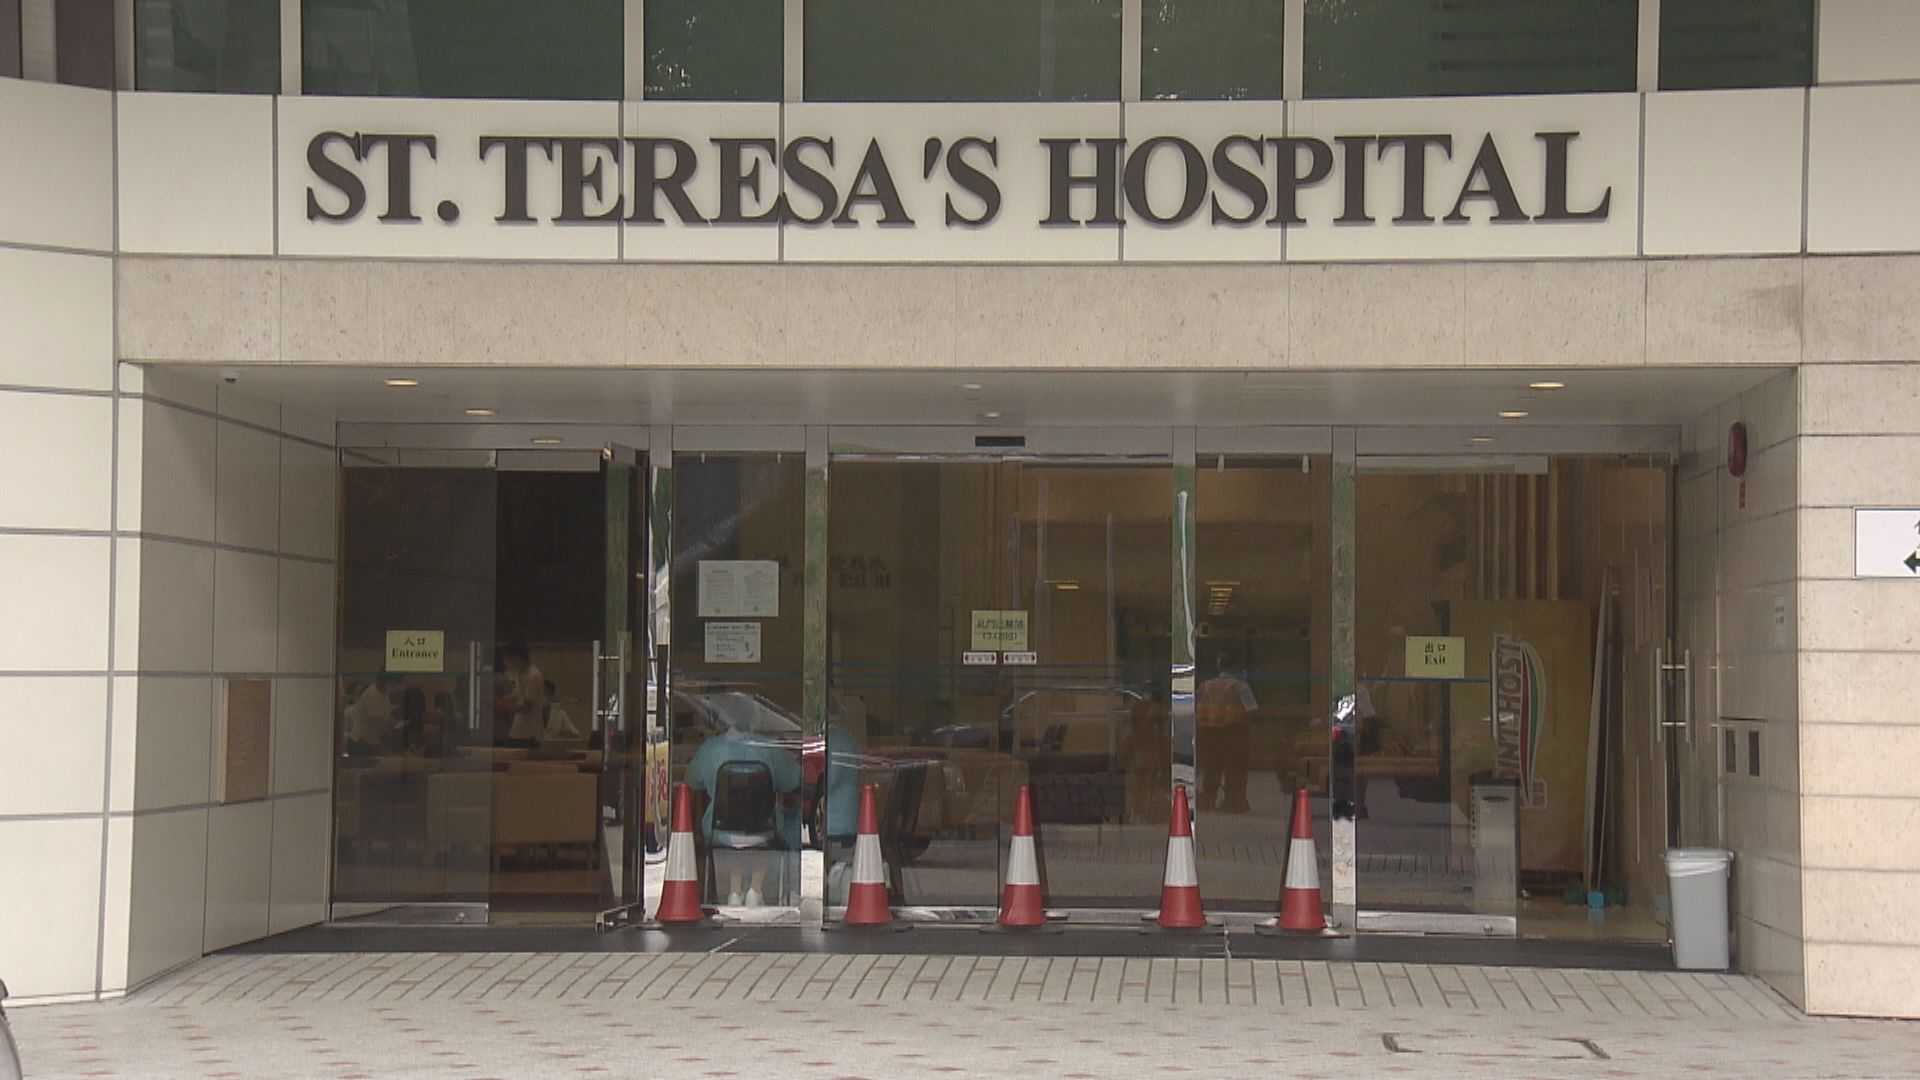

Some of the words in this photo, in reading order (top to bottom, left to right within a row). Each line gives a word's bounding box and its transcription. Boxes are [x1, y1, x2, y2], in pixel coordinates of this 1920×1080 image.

[306, 131, 461, 222] ST.
[478, 134, 1002, 227] TERESA'S
[1038, 131, 1612, 227] HOSPITAL
[404, 637, 426, 647] 入口
[1424, 641, 1446, 653] 出口
[391, 647, 439, 659] Entrance
[1424, 653, 1446, 665] Exit
